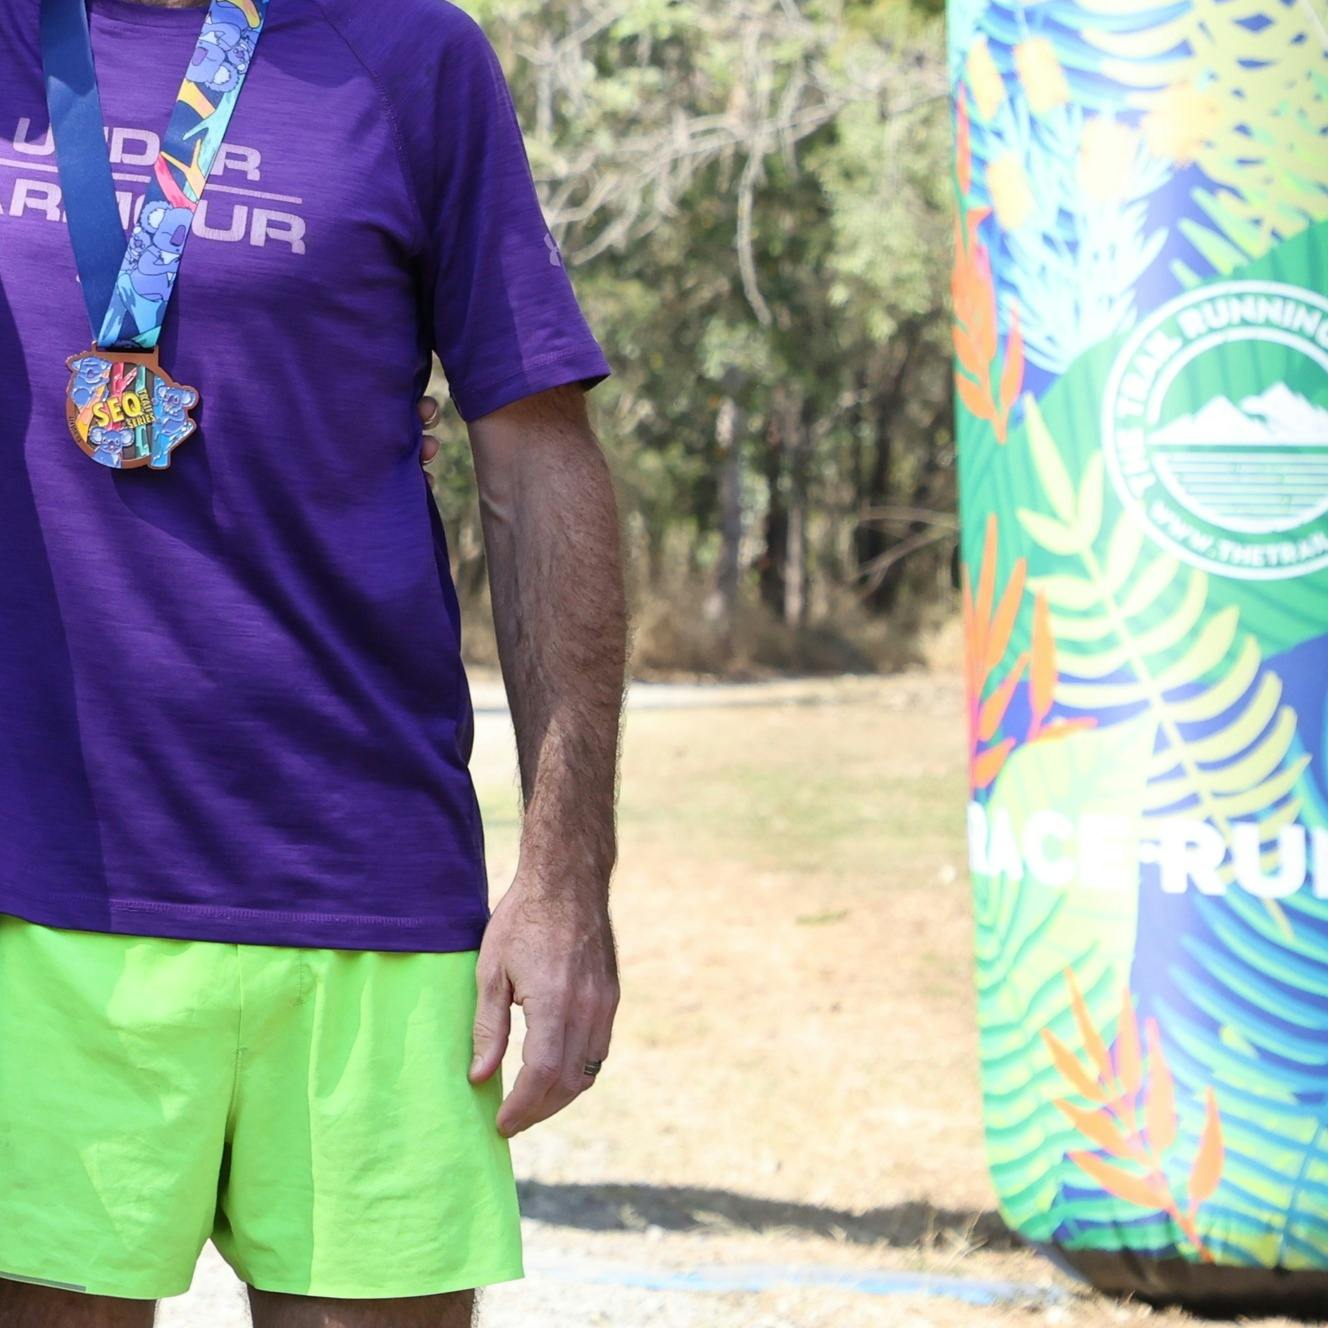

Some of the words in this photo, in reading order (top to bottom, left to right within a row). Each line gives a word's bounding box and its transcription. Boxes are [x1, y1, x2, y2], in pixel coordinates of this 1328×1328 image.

[12, 117, 262, 181] UDR
[92, 390, 145, 427] SEQ
[126, 414, 156, 429] SERIES
